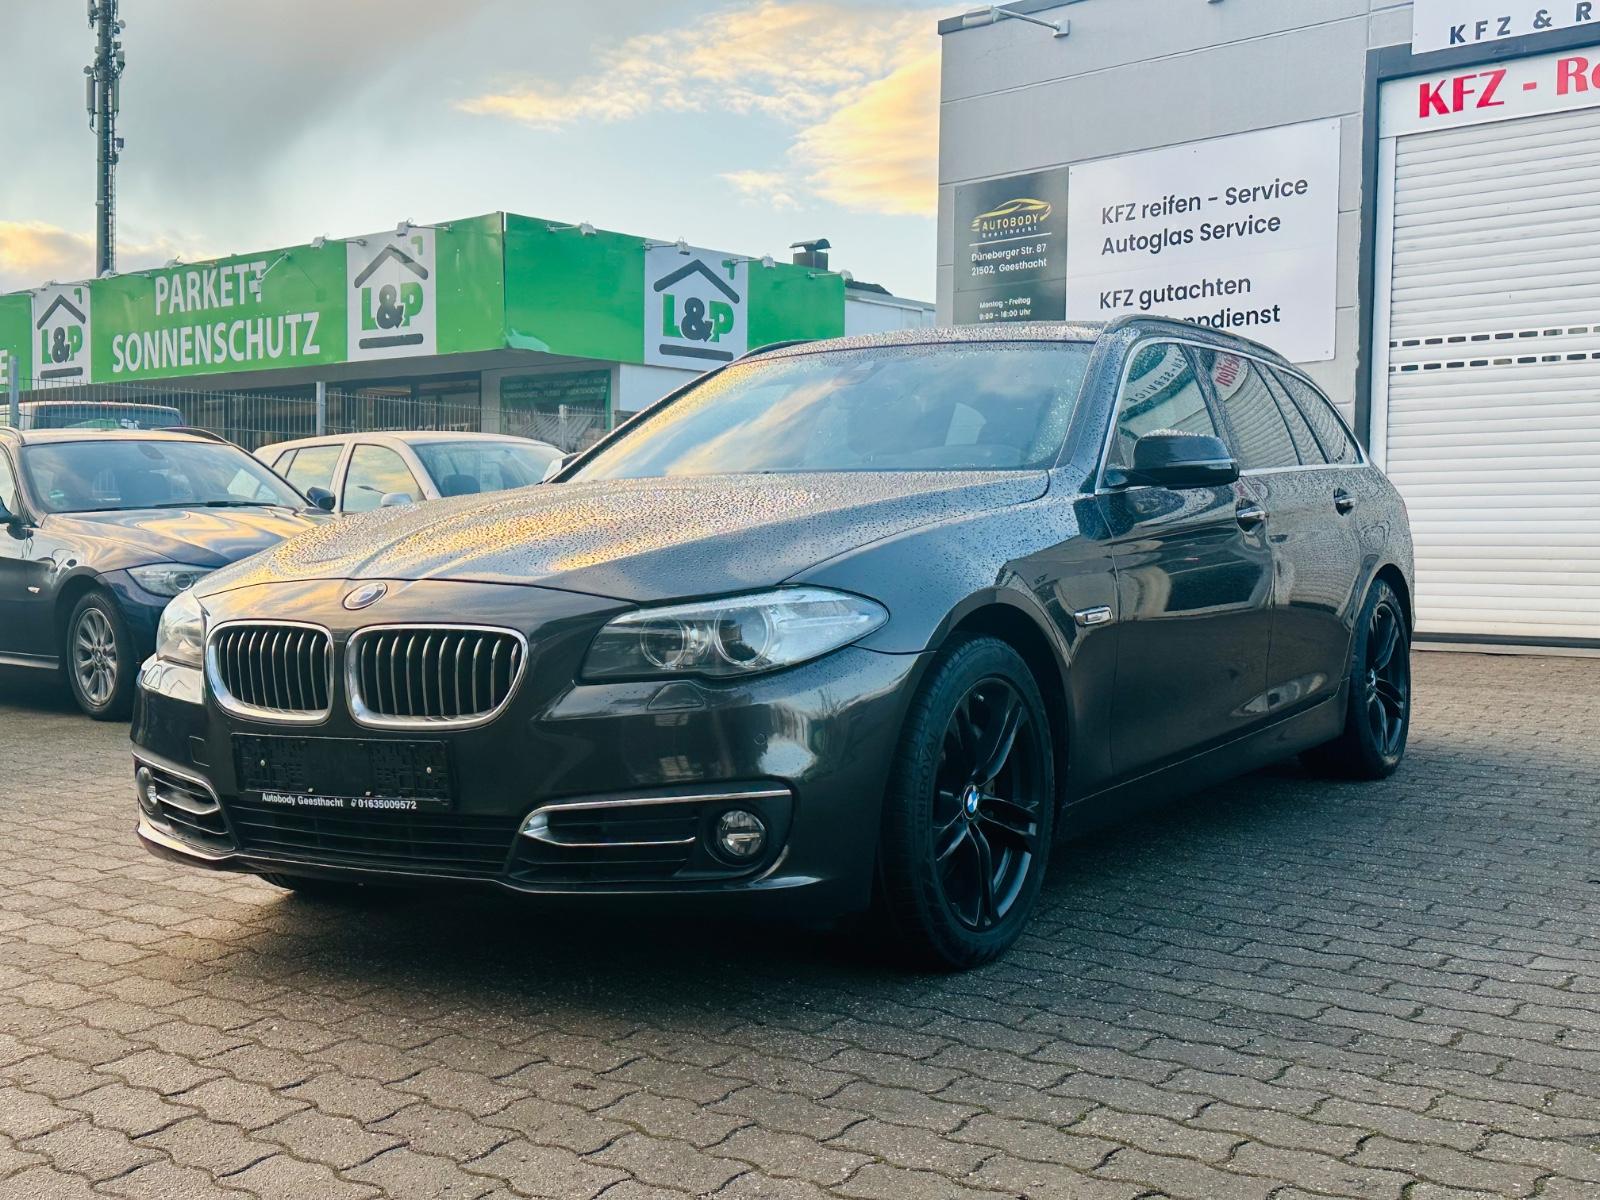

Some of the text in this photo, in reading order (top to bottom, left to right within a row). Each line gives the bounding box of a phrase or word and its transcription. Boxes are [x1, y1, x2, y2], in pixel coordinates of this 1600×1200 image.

[1450, 1, 1593, 45] KFZ & R
[1419, 69, 1507, 118] KFZ
[1523, 82, 1537, 91] -
[982, 213, 1039, 231] AUTOBODY
[1102, 203, 1136, 225] KFZ
[1141, 194, 1201, 219] reifen
[1225, 178, 1309, 206] Service
[1021, 246, 1035, 255] Str.
[1101, 214, 1281, 255] Autoglas Service
[155, 260, 267, 316] PARKETT
[361, 281, 424, 332] L&P
[1099, 277, 1251, 311] KFZ gutachten
[662, 293, 735, 343] L&P
[41, 323, 83, 365] L&P
[112, 311, 320, 373] SONNENSCHUTZ
[261, 792, 296, 806] Autobody
[358, 798, 417, 810] 01635009572
